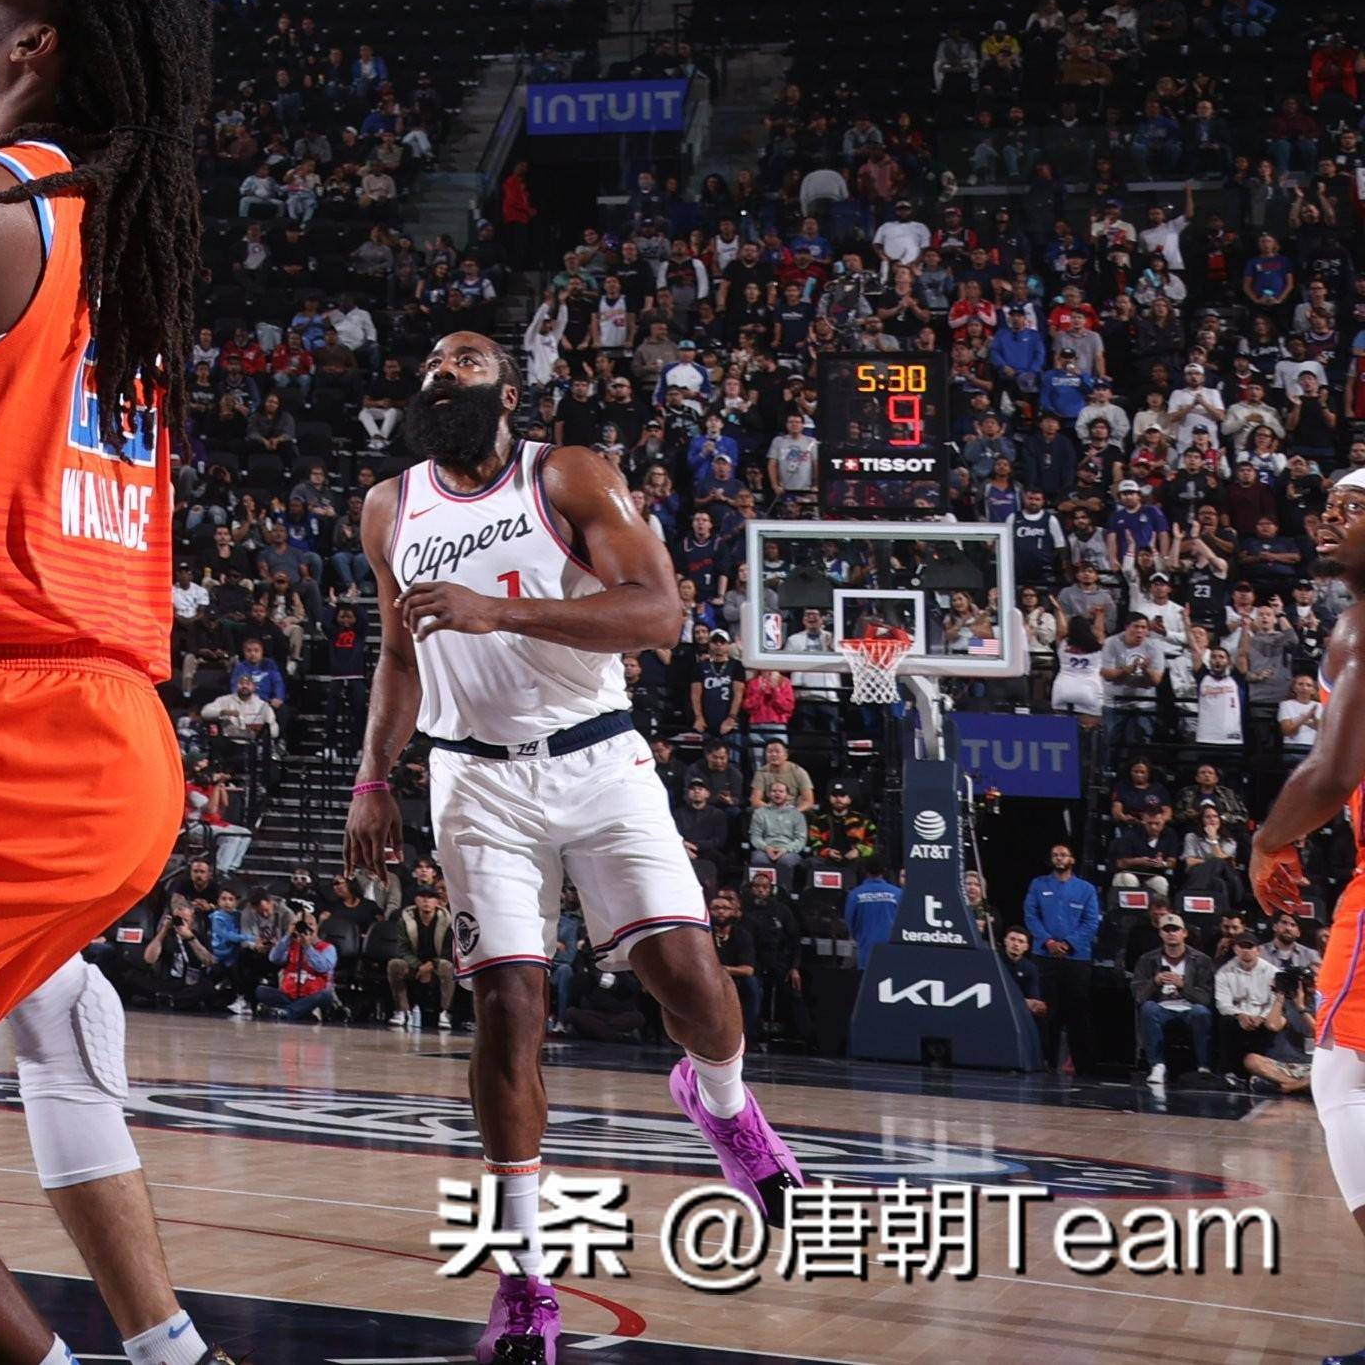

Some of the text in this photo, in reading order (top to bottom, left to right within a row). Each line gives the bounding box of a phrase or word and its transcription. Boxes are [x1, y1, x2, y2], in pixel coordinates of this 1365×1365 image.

[532, 90, 681, 125] INTUIT
[857, 365, 927, 392] 5:30
[888, 394, 921, 447] 9
[859, 457, 937, 473] TISSOT
[401, 511, 533, 588] Clippers
[496, 570, 521, 599] 1
[1194, 584, 1212, 598] 23
[962, 739, 1069, 772] TUIT
[910, 844, 952, 860] AT&T
